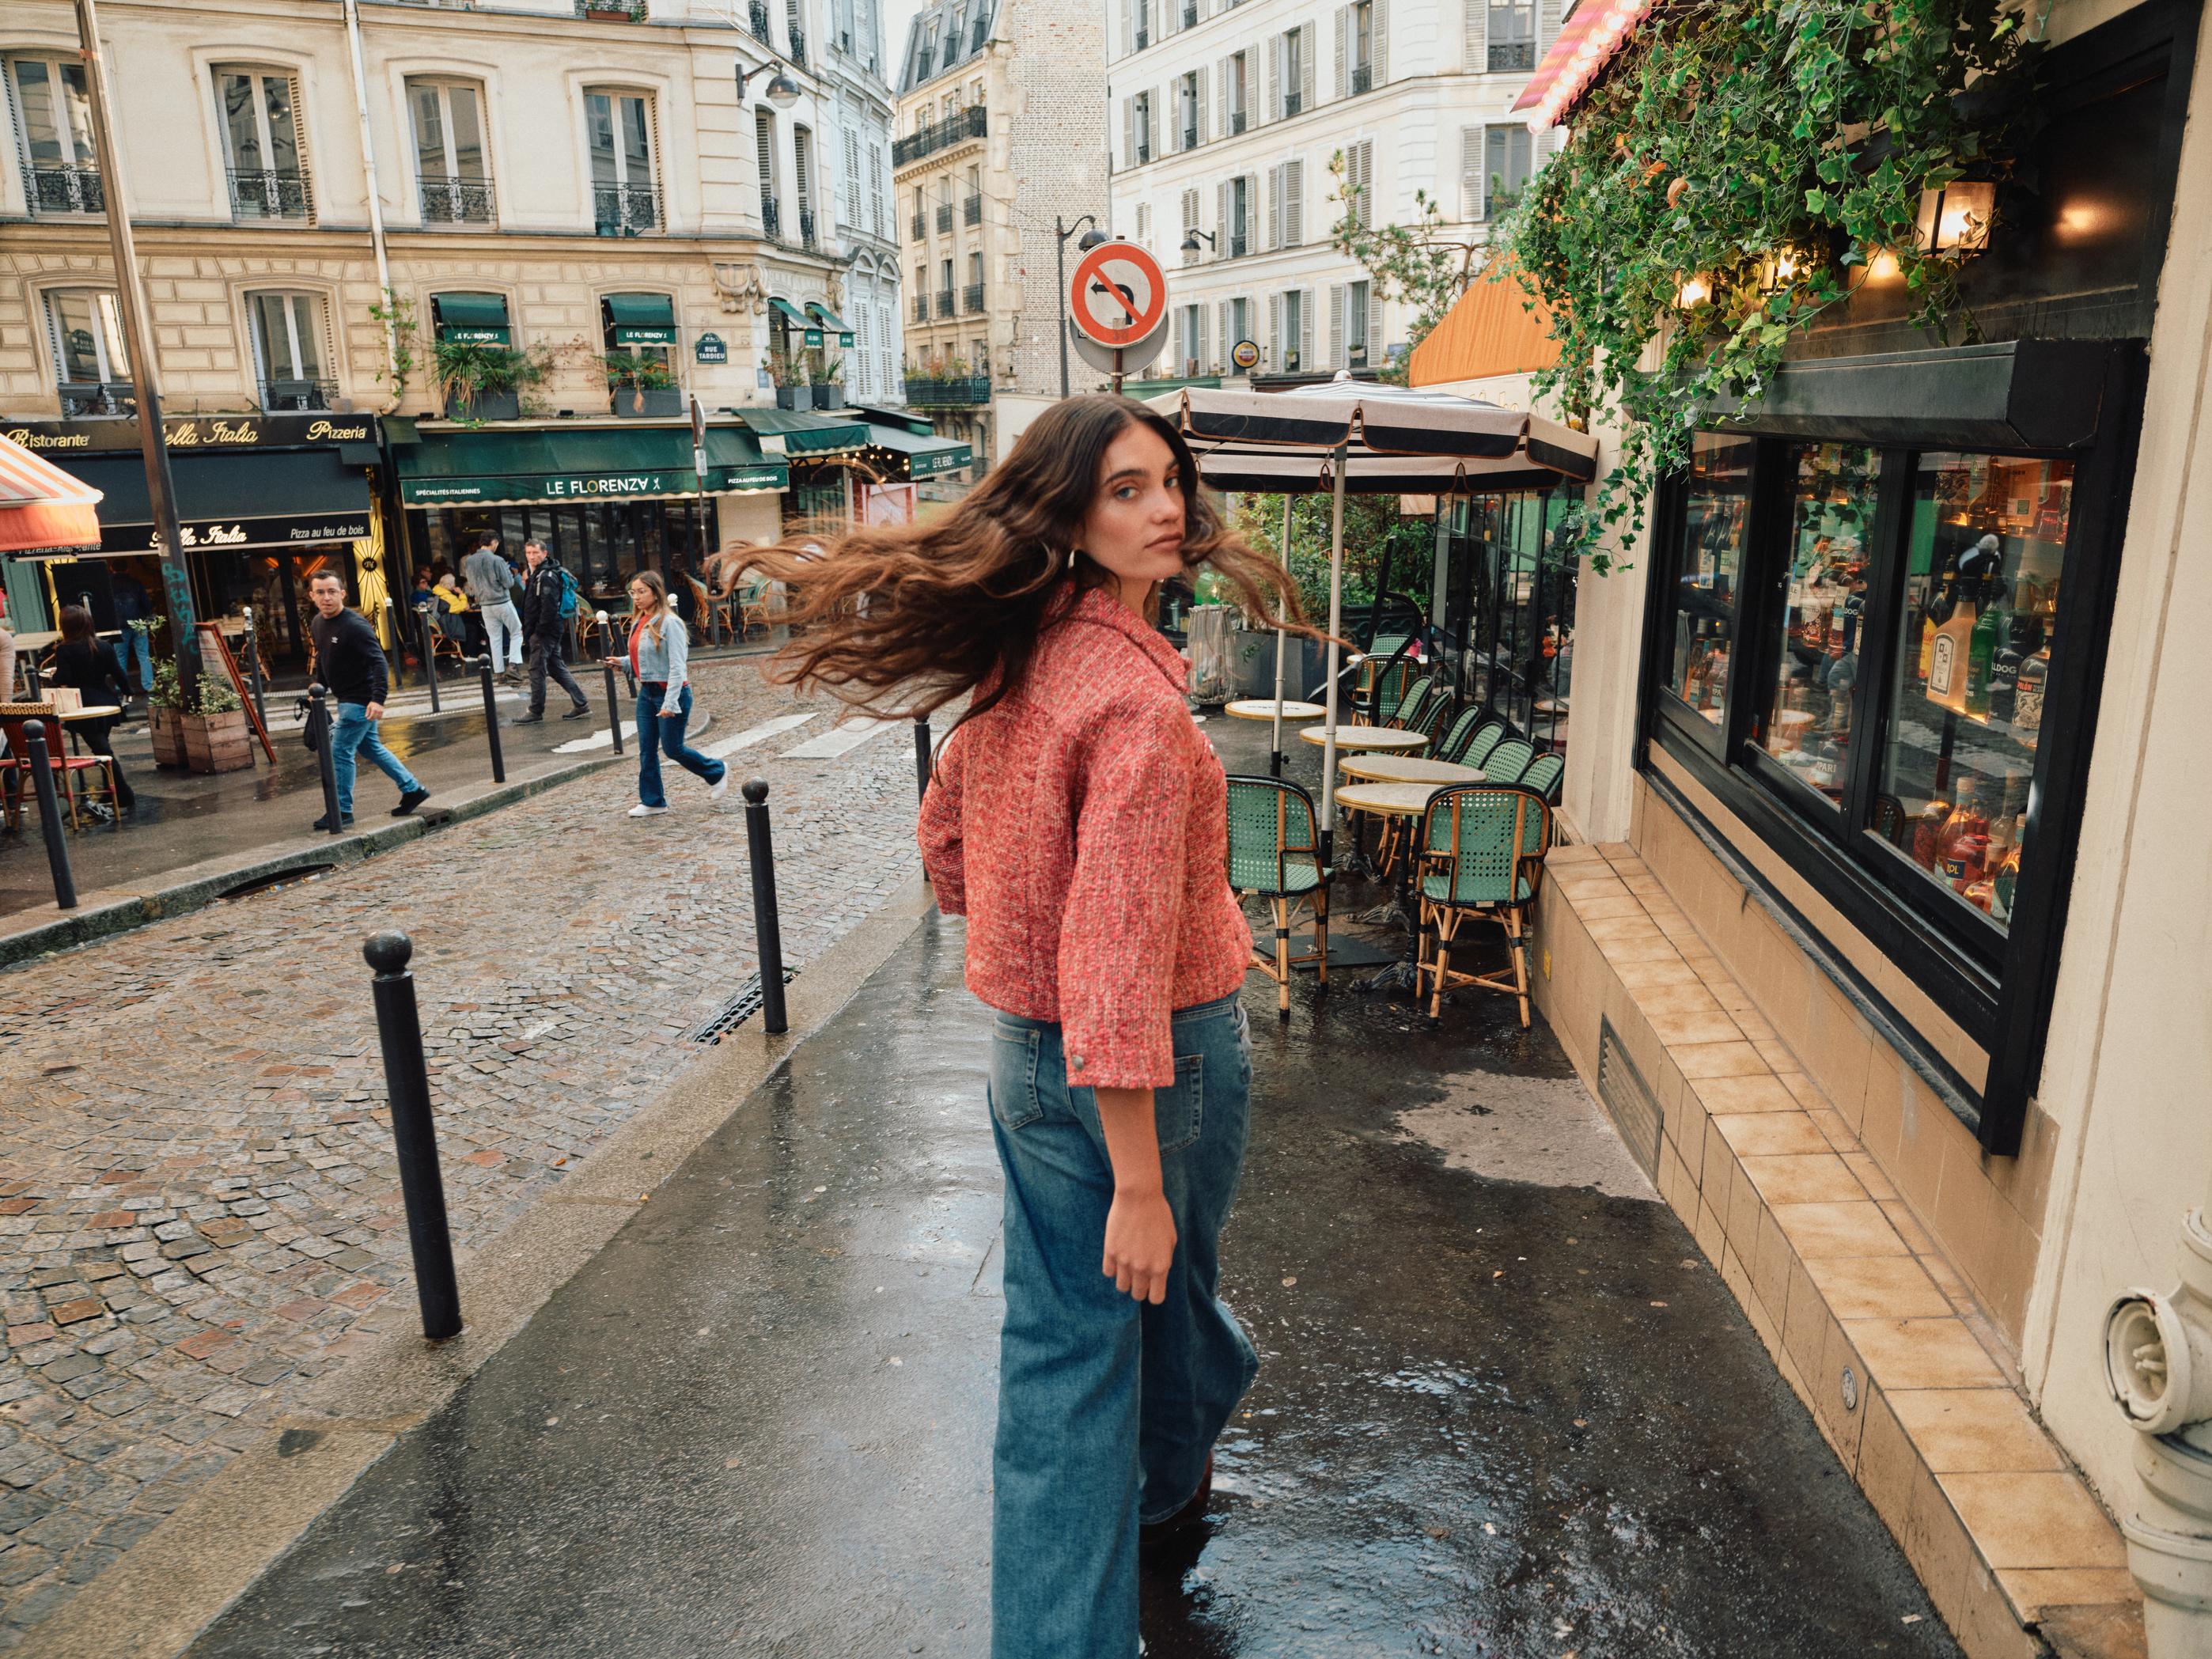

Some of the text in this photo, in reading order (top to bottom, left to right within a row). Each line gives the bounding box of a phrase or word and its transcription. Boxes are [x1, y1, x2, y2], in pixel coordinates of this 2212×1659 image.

[6, 428, 89, 448] Ristorante
[162, 421, 259, 445] ella Italia
[306, 420, 367, 440] Pizzeria
[546, 477, 649, 494] LE FLORENZA
[200, 525, 247, 544] Italia
[290, 525, 364, 539] Pizza au feu de bois
